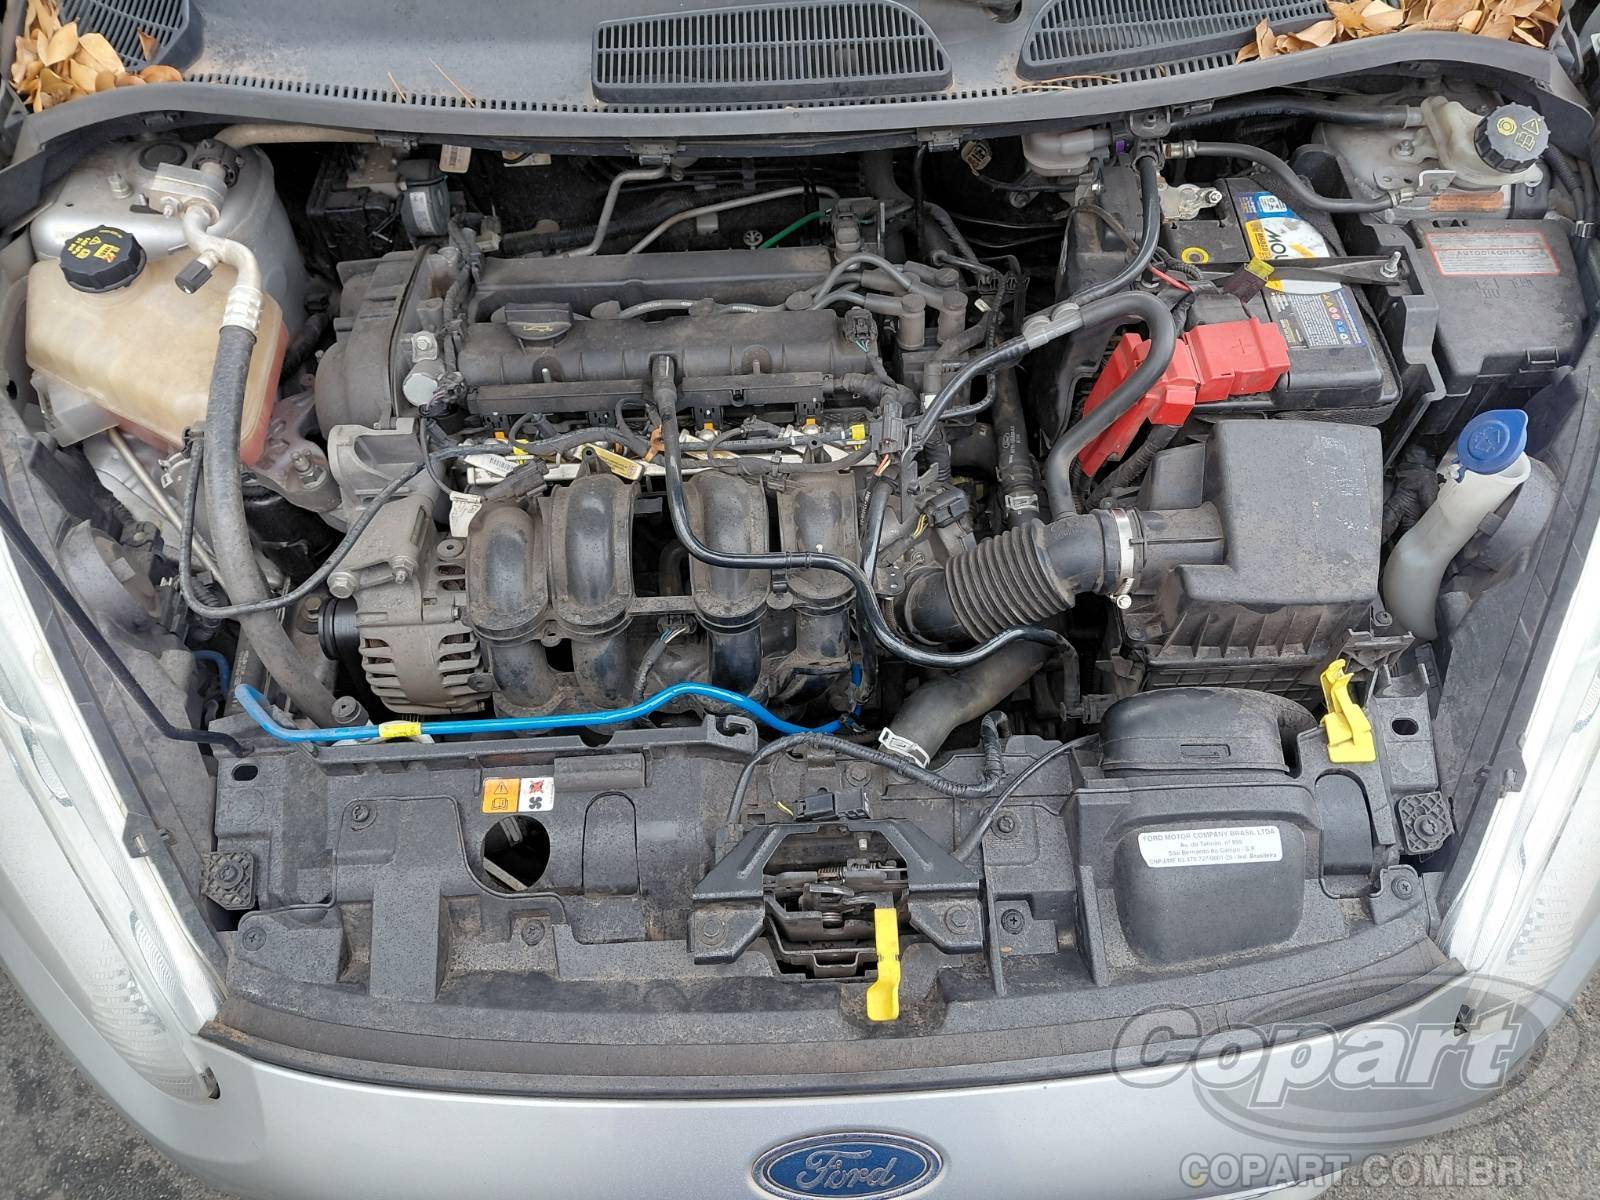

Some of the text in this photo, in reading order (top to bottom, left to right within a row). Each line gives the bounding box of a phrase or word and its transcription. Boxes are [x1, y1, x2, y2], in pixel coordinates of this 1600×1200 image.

[1143, 828, 1276, 842] FORD MOTOR COMPANY BRASIL LTDA
[796, 1149, 898, 1190] Ford
